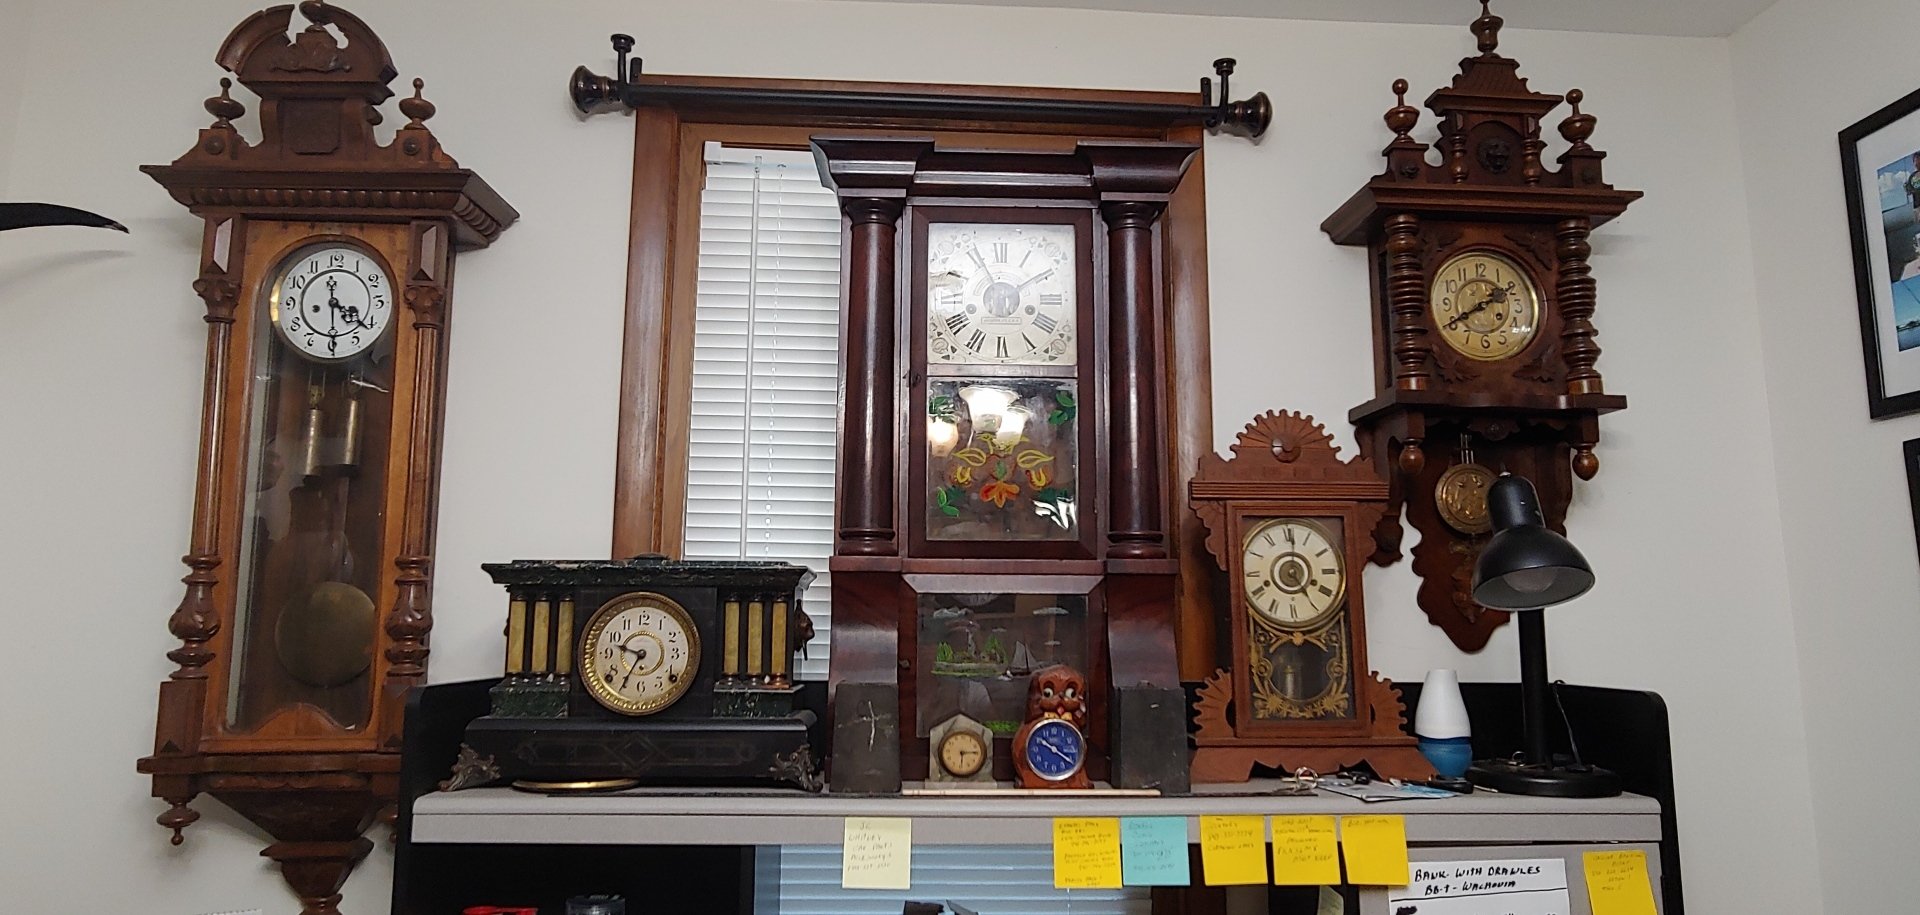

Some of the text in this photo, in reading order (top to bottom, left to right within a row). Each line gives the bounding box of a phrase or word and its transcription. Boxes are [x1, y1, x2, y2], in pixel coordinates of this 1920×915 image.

[993, 242, 1008, 263] XII
[307, 260, 319, 274] 11
[327, 254, 344, 268] 12
[353, 260, 359, 273] 1
[1458, 268, 1467, 281] 11
[1475, 263, 1486, 277] 12
[289, 275, 305, 289] 10
[368, 274, 380, 288] 2
[1445, 280, 1457, 293] 10
[286, 296, 296, 310] 9
[1040, 293, 1062, 305] III
[1443, 297, 1451, 312] 9
[1514, 299, 1523, 313] 3
[290, 316, 301, 331] 8
[304, 332, 315, 346] 7
[351, 331, 360, 345] 5
[964, 328, 987, 353] VII
[1464, 330, 1472, 344] 7
[1481, 335, 1490, 349] 6
[1498, 331, 1507, 345] 5
[995, 336, 1009, 358] VI
[623, 619, 631, 630] 11
[638, 614, 650, 626] 12
[609, 631, 621, 643] 10
[668, 632, 677, 643] 2
[604, 647, 613, 659] 9
[671, 647, 680, 660] 3
[610, 663, 618, 676] 8
[636, 681, 646, 693] 6
[1455, 867, 1483, 878] WITH
